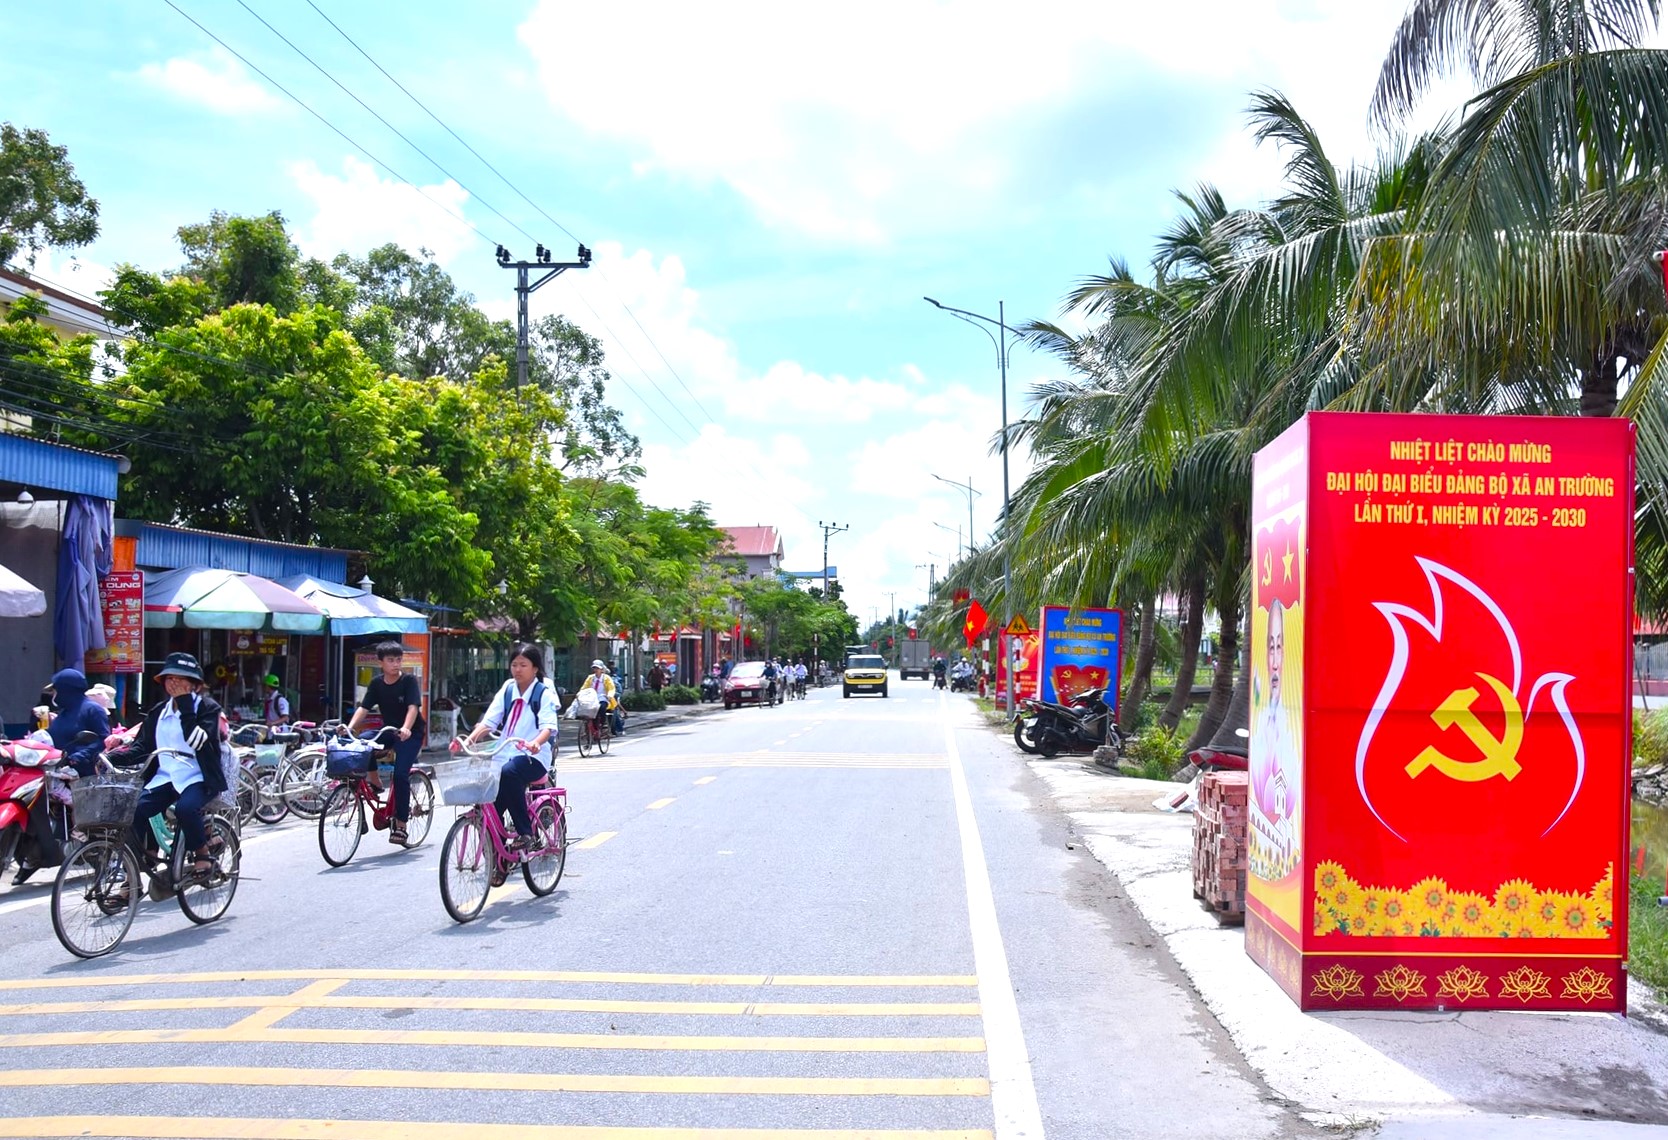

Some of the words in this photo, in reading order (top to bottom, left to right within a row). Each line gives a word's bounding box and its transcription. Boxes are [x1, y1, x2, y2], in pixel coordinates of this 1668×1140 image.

[1390, 438, 1431, 465] NHIỆT
[1435, 438, 1463, 466] LIỆT
[1467, 439, 1505, 463] CHÀO
[1509, 440, 1552, 464] MỪNG
[1326, 472, 1351, 496] ĐẠI
[1355, 469, 1378, 497] HỘI
[1382, 473, 1406, 498] ĐẠI
[1410, 465, 1442, 494] BIỂU
[1446, 470, 1485, 495] ĐẢNG
[1488, 472, 1508, 500] BỘ
[1512, 474, 1531, 496] XÃ
[1534, 477, 1555, 496] AN
[1558, 473, 1614, 497] TRƯỜNG
[1354, 497, 1382, 523] LẦN
[1386, 500, 1414, 524] THỨ
[1417, 506, 1428, 527] I,
[1432, 503, 1479, 529] NHIỆM
[1482, 502, 1501, 526] KỲ
[1504, 506, 1539, 527] 2025
[1551, 507, 1587, 528] 2030
